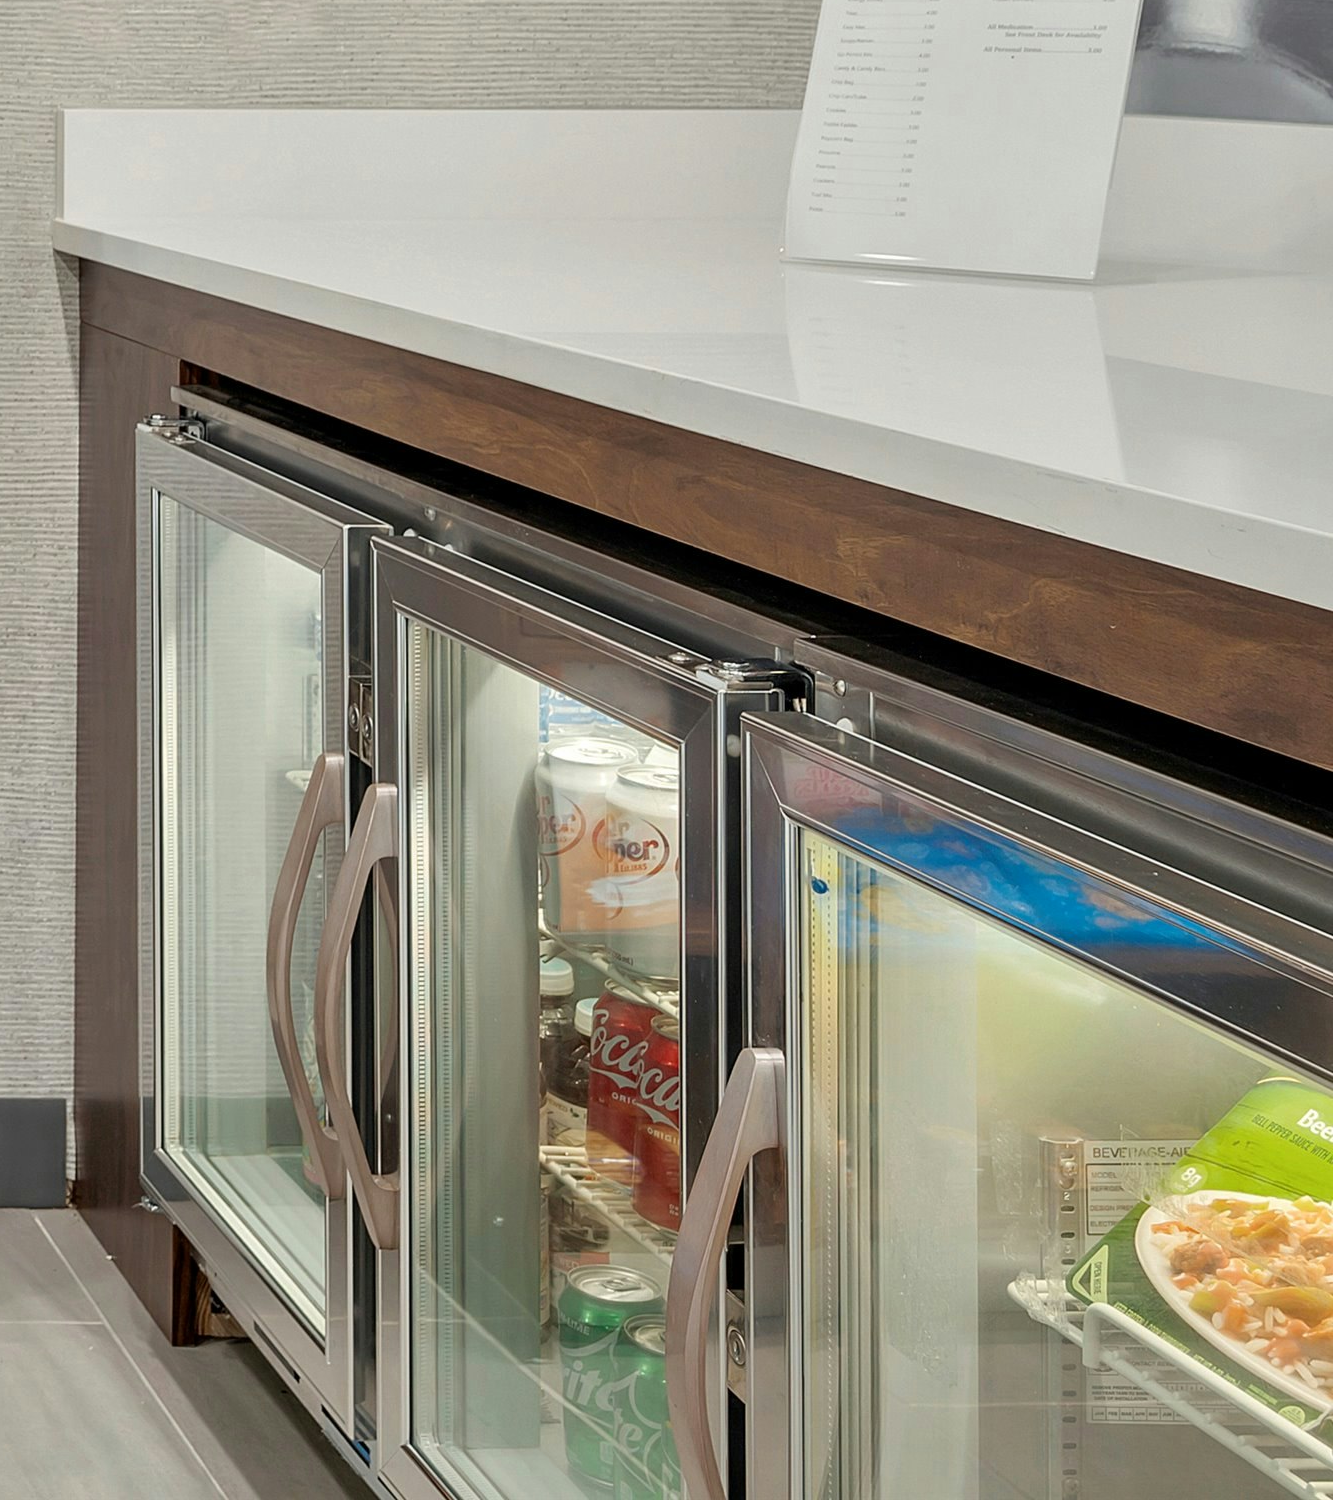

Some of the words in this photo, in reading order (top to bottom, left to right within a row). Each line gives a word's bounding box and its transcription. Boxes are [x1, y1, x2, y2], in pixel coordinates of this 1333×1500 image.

[1252, 1114, 1266, 1128] BELL
[1267, 1119, 1292, 1140] PEPPER
[1289, 1133, 1314, 1152] SAUCE
[1310, 1145, 1330, 1161] WITH
[1297, 1108, 1333, 1143] Bee
[1181, 1167, 1202, 1188] 8g
[1094, 1261, 1102, 1277] OPEN
